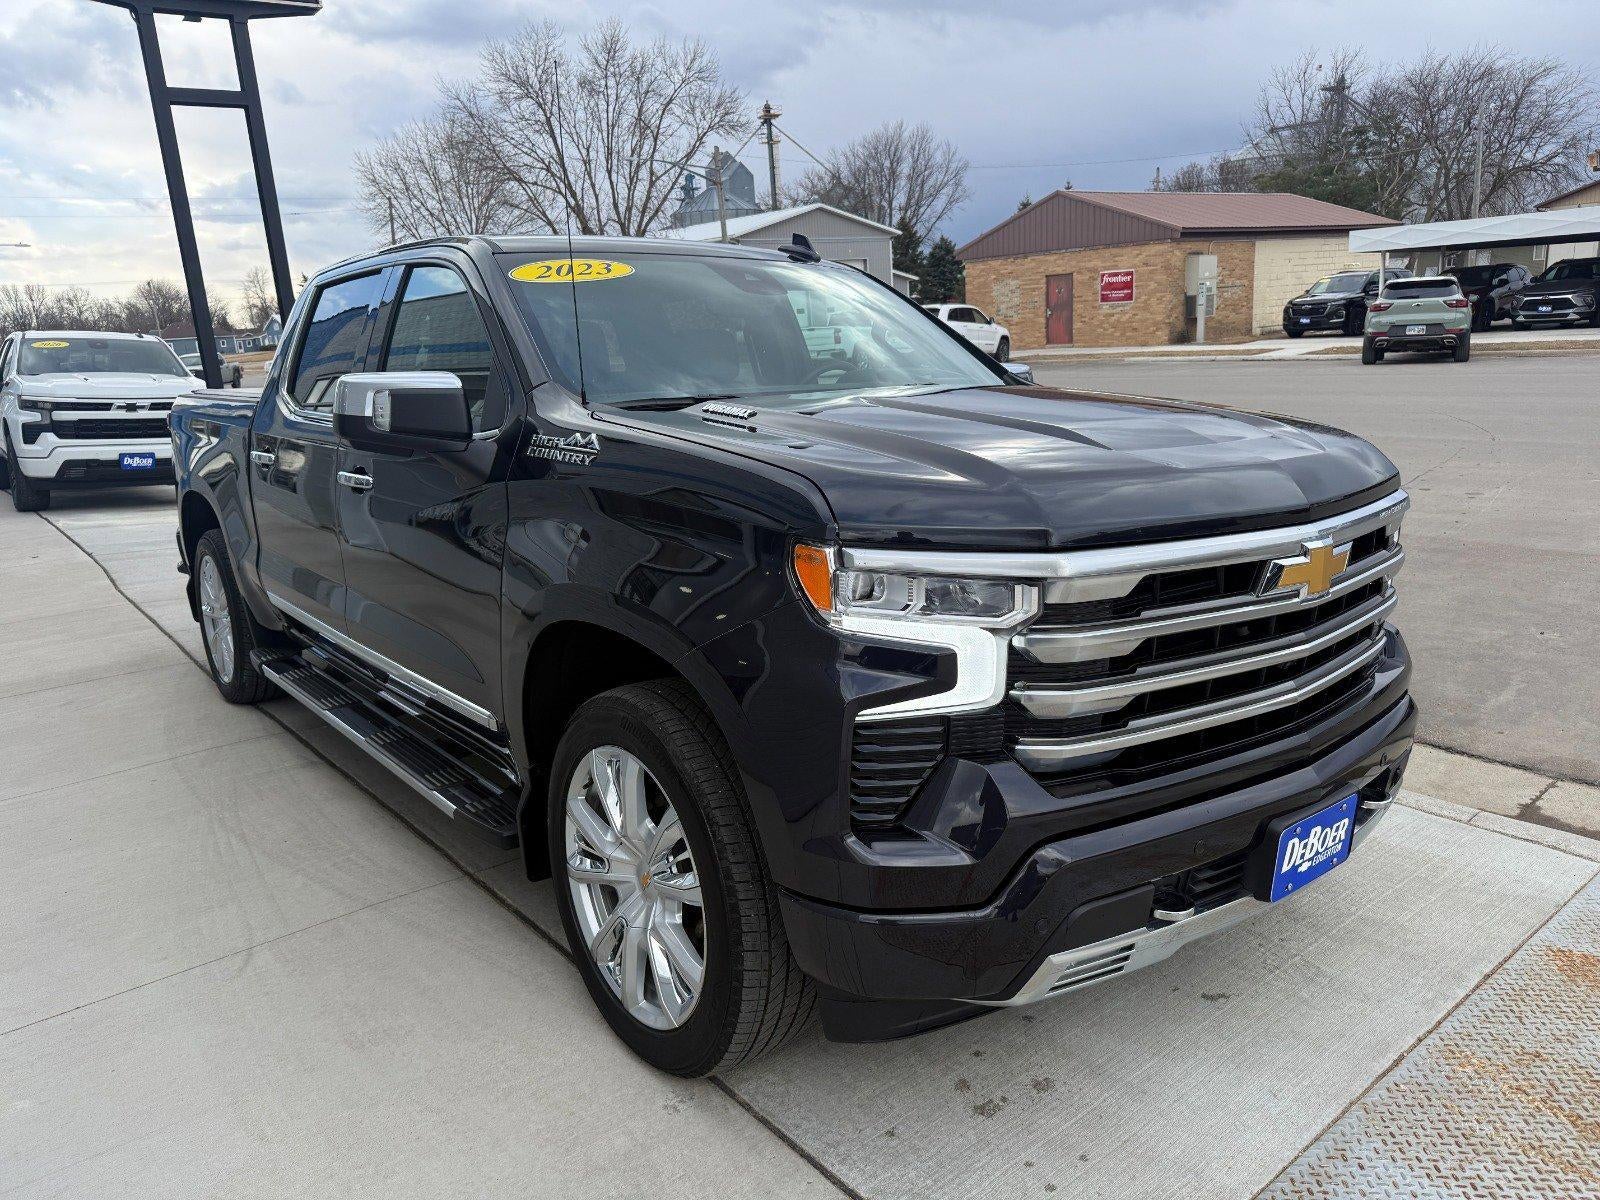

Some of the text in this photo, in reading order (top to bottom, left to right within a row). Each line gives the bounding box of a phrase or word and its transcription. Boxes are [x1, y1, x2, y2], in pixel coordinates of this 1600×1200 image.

[535, 262, 612, 279] 2023
[1101, 274, 1132, 285] frontier
[531, 434, 565, 447] HIGH
[527, 446, 597, 466] COUNTRY
[1312, 842, 1342, 866] EDGERTON
